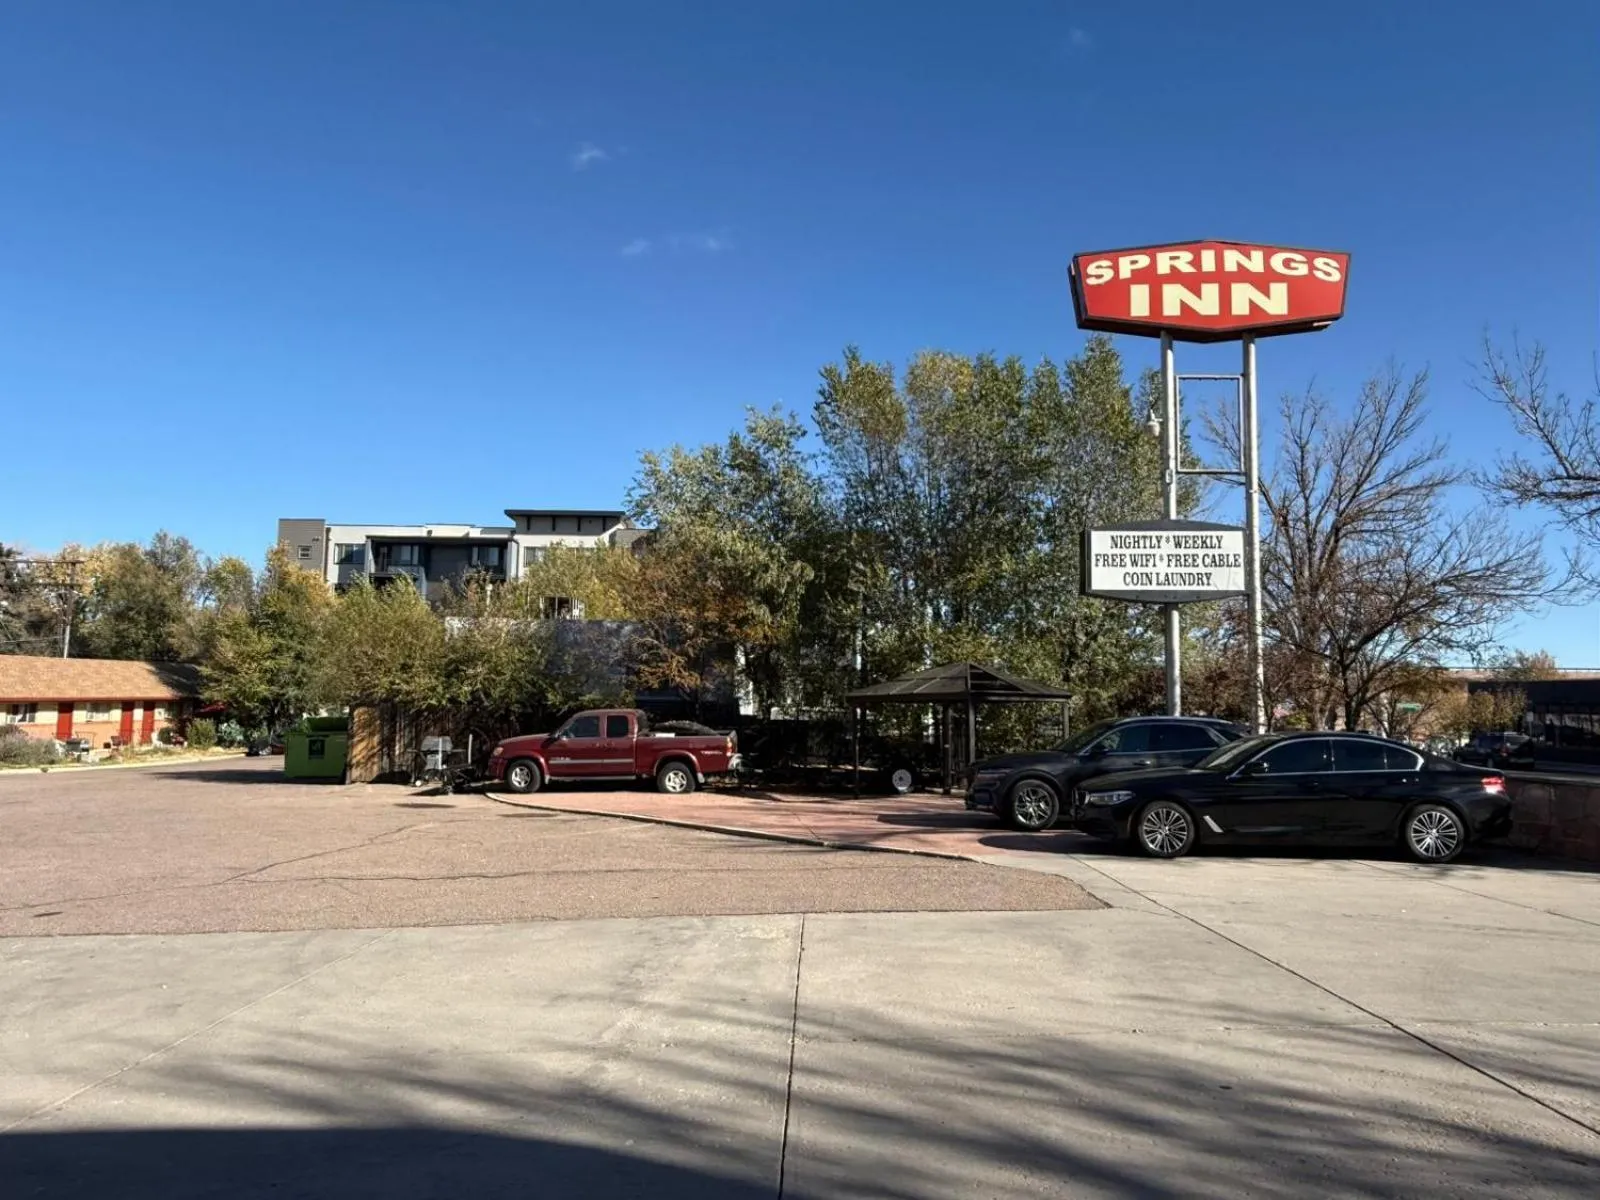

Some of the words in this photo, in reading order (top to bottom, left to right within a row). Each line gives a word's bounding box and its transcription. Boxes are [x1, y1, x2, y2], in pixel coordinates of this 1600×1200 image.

[1086, 249, 1342, 286] SPRINGS
[1129, 282, 1289, 317] INN
[1110, 535, 1163, 550] NIGHTLY
[1172, 535, 1224, 550] WEEKLY
[1094, 553, 1127, 568] FREE
[1129, 553, 1157, 568] WIFI
[1166, 553, 1200, 568] FREE
[1201, 553, 1242, 568] CABLE
[1123, 572, 1153, 587] COIN
[1155, 572, 1212, 587] LAUNDRY
